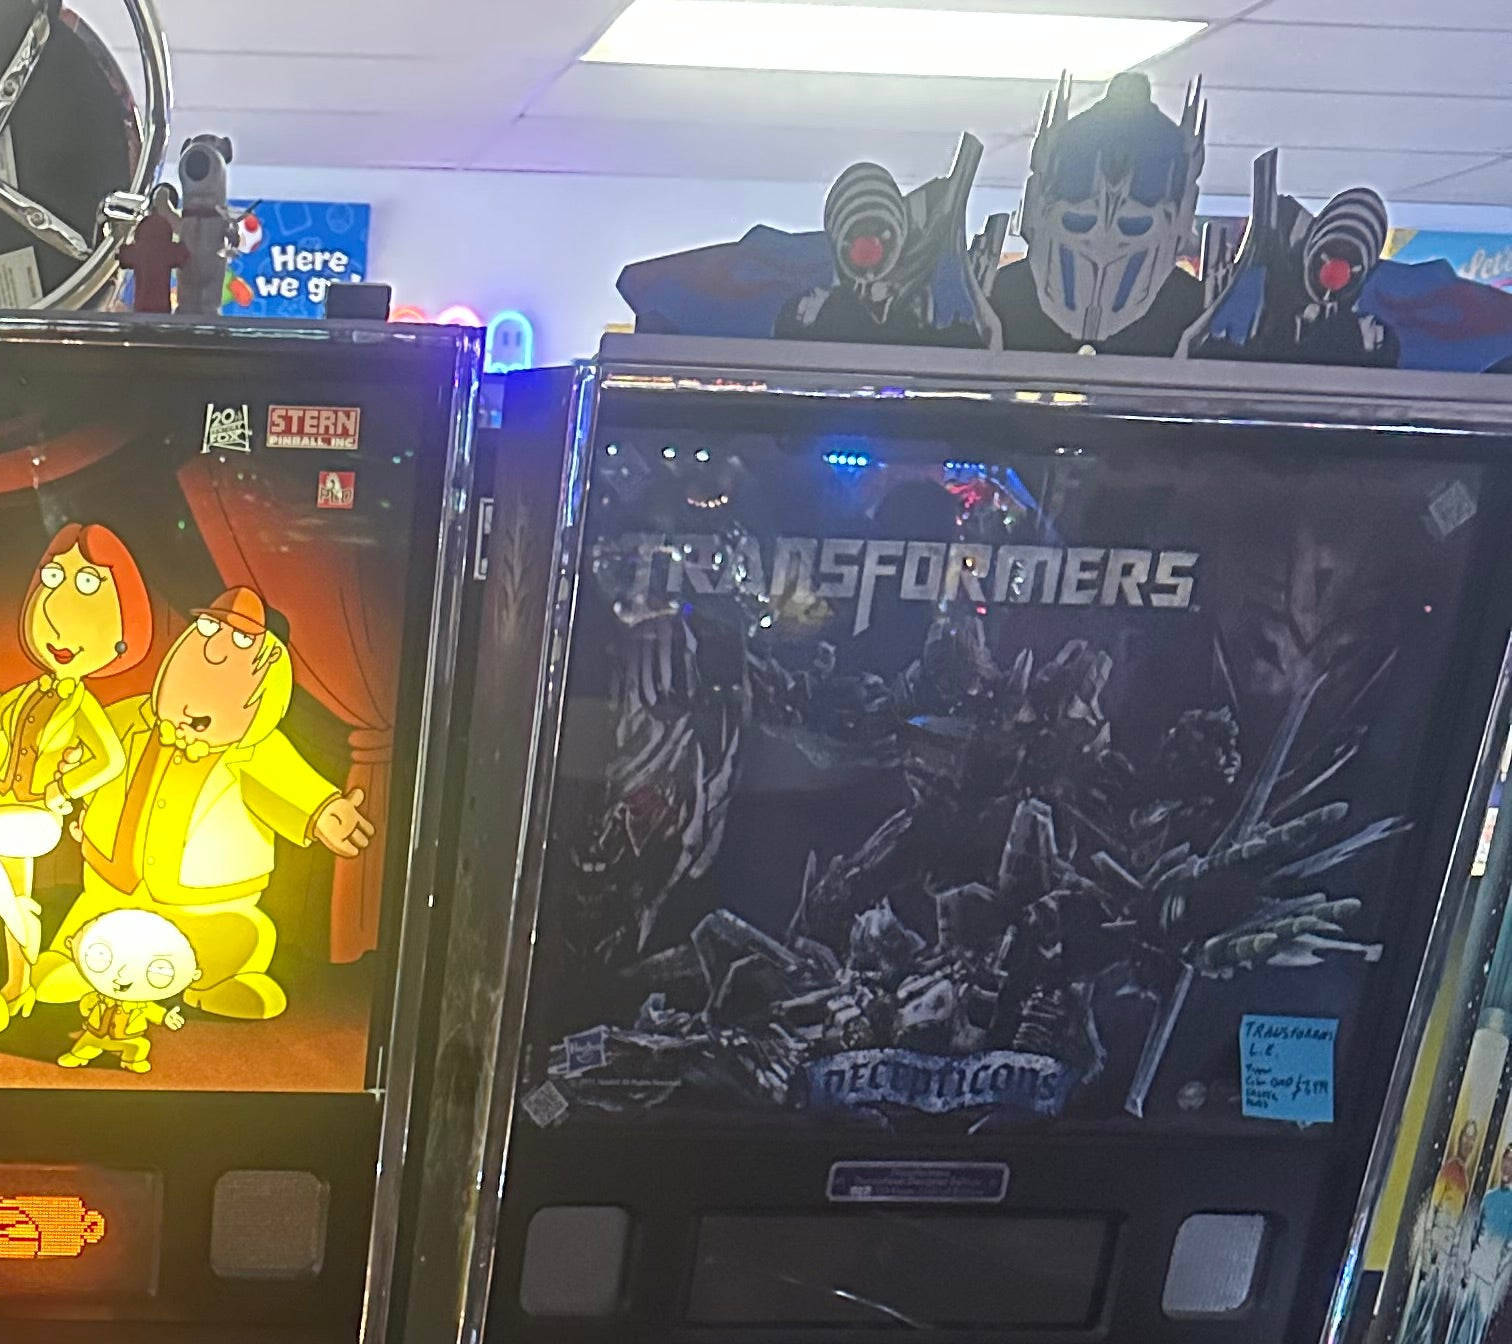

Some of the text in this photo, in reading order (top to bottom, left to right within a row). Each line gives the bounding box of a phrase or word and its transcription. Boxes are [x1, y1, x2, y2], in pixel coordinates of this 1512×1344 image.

[271, 245, 348, 272] Here
[256, 276, 299, 298] we
[271, 409, 356, 435] STERN
[619, 532, 1199, 637] TRANSFORMERS
